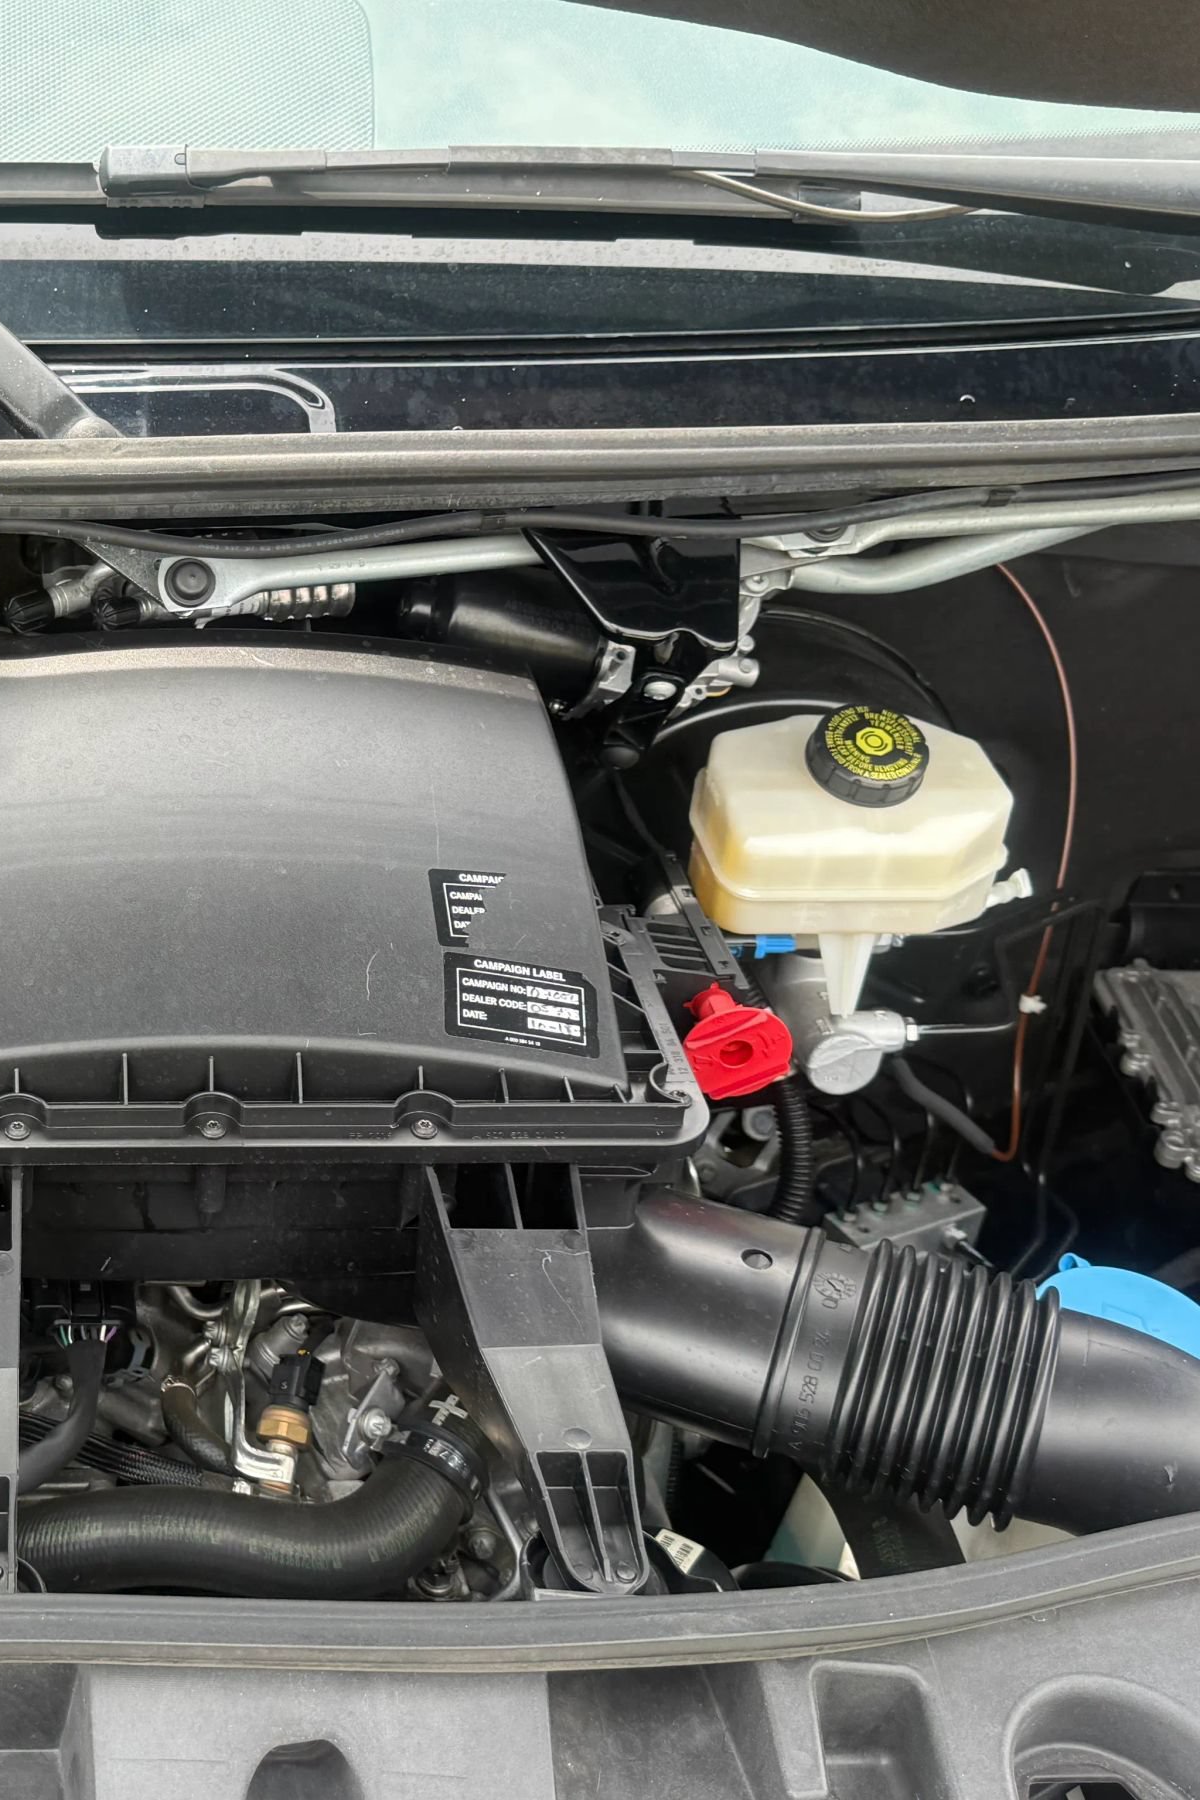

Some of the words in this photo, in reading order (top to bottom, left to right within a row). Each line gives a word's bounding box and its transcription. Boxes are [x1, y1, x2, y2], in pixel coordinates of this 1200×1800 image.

[474, 959, 530, 976] CAMPAIGN
[532, 968, 566, 982] LABEL
[462, 977, 508, 992] CAMPAIGN
[510, 985, 527, 995] NO:
[462, 993, 497, 1006] DEALER
[498, 998, 527, 1011] CODE:
[462, 1008, 488, 1021] DATE:
[799, 1374, 819, 1404] 528
